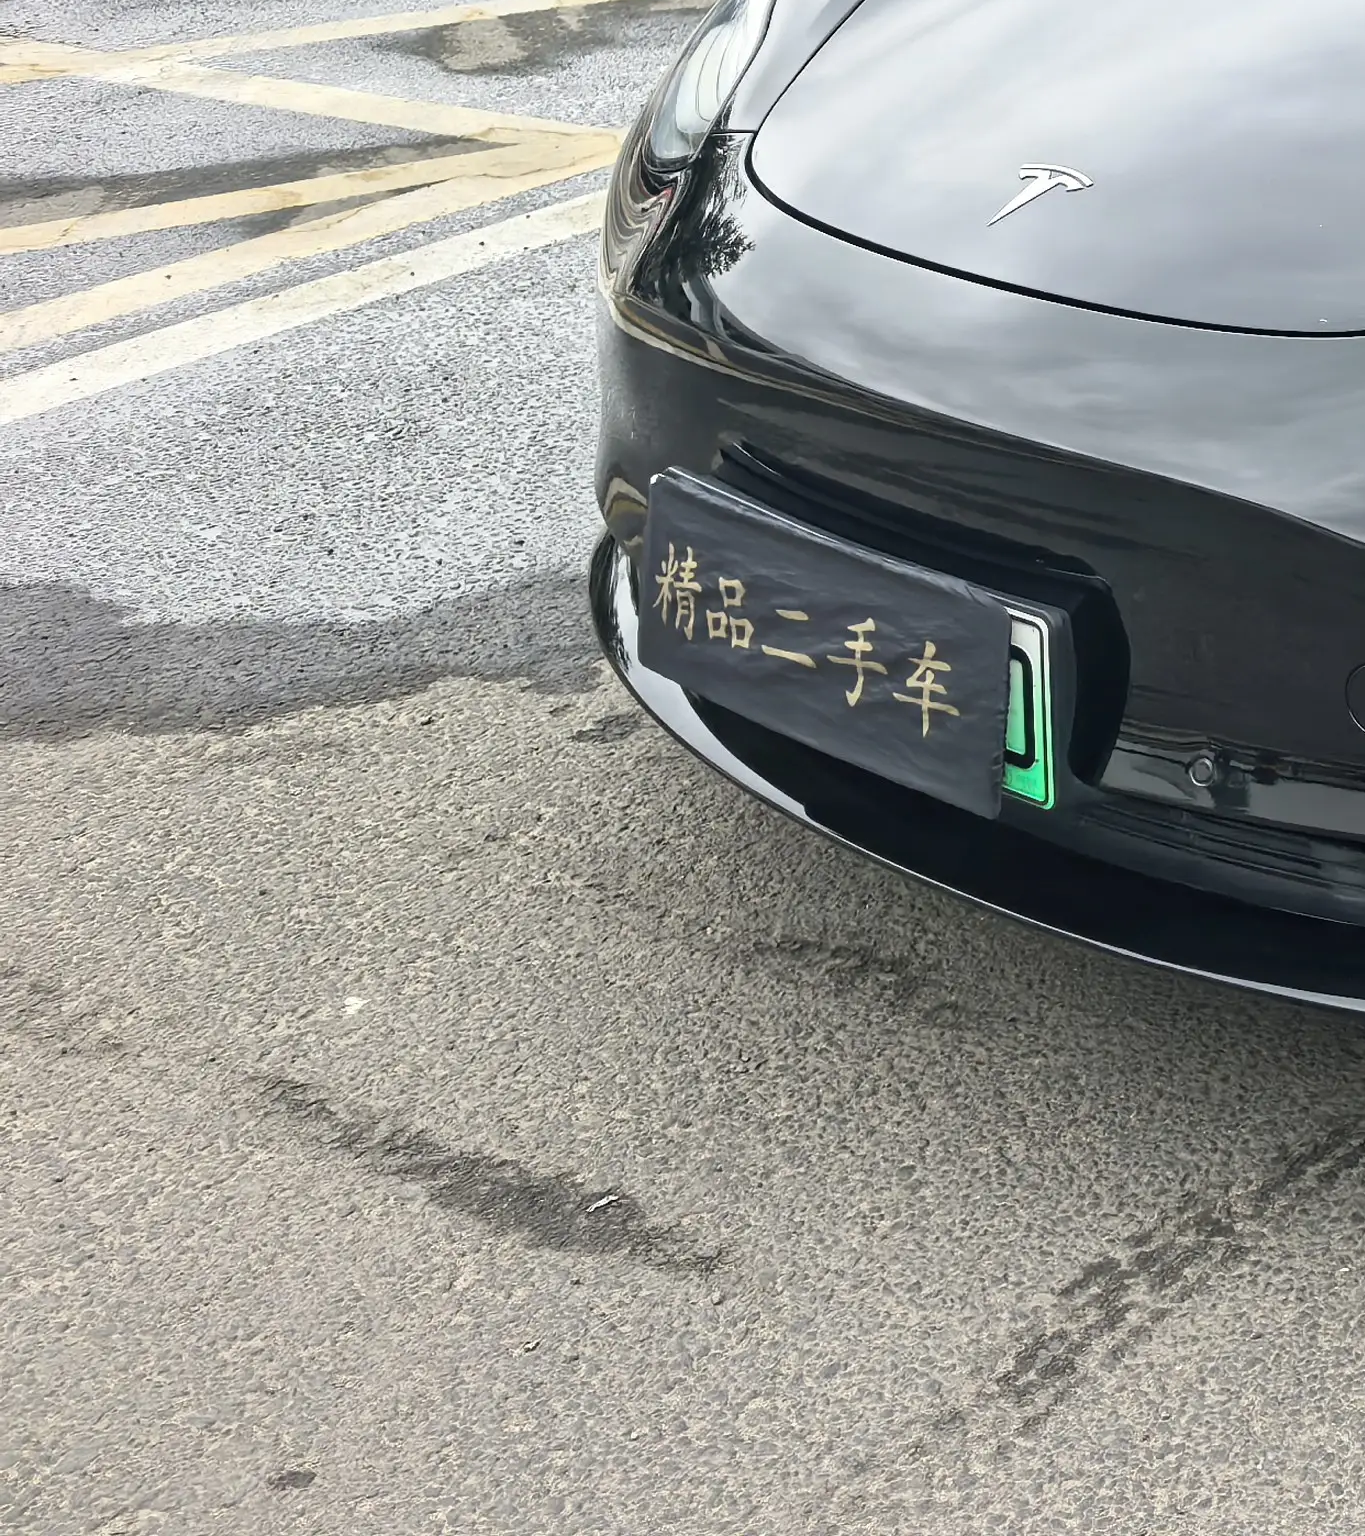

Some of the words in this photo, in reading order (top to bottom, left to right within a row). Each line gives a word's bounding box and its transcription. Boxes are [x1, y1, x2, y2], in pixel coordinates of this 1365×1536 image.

[652, 542, 960, 737] 精品二手车
